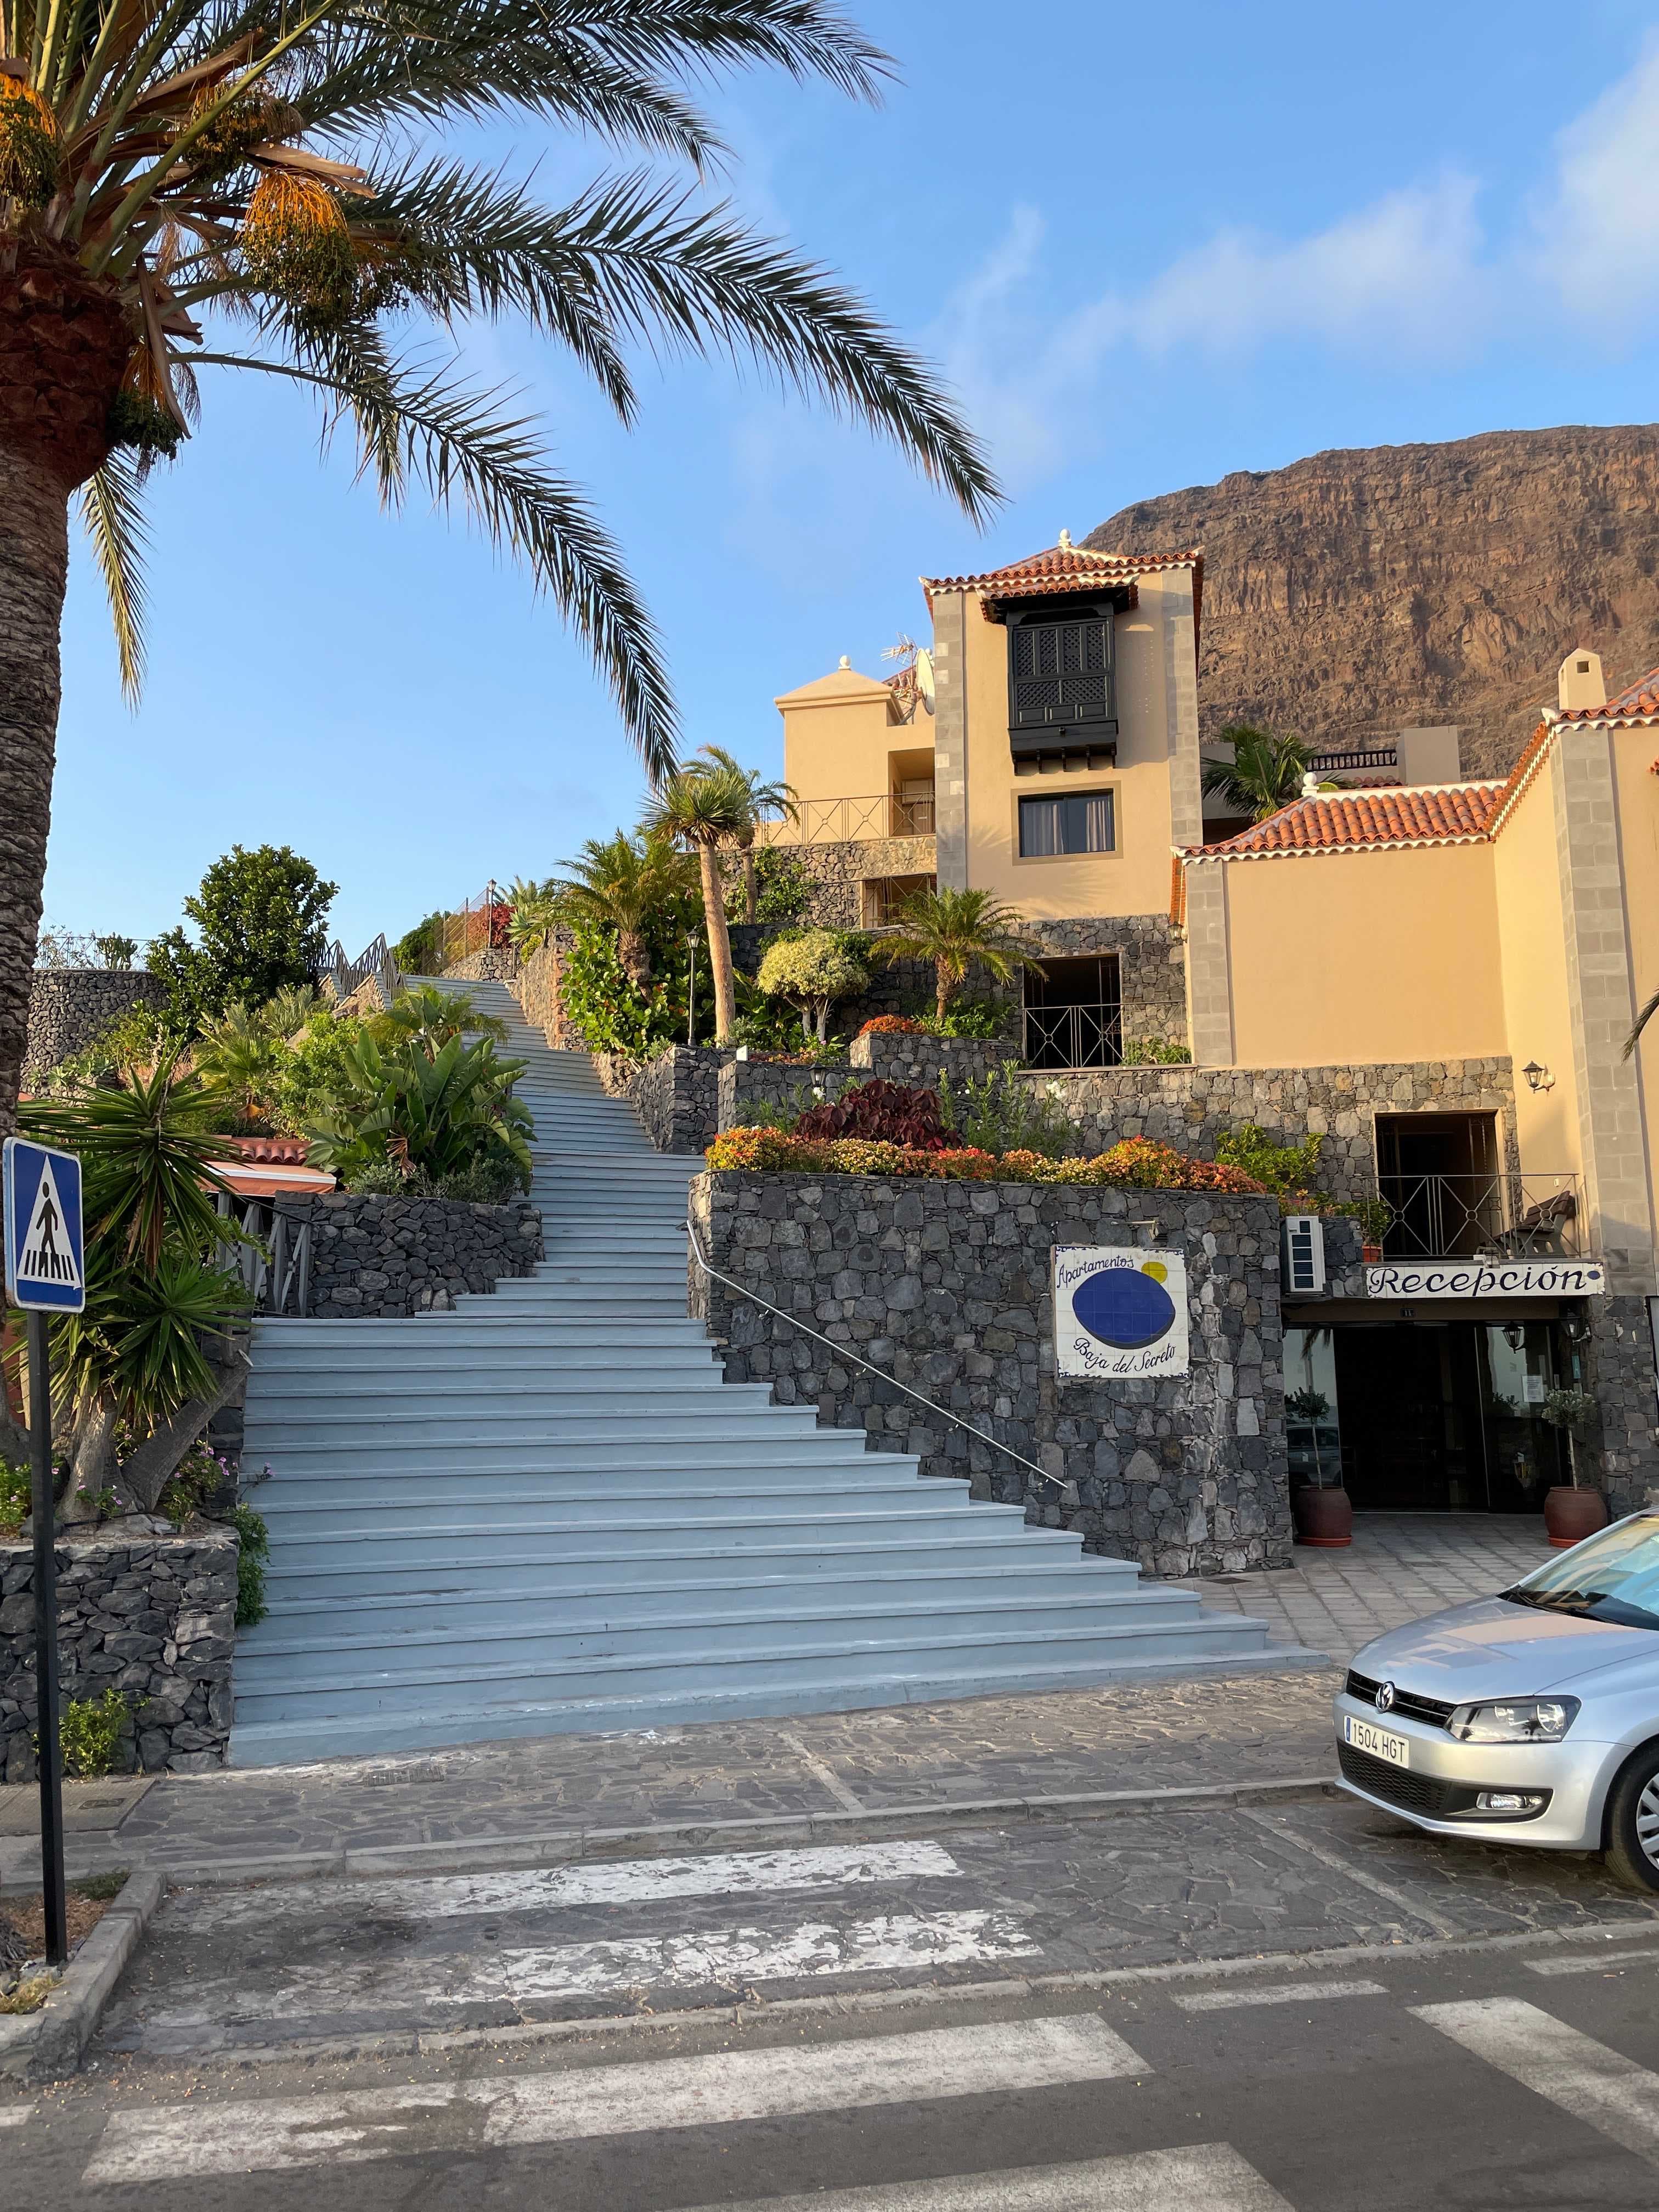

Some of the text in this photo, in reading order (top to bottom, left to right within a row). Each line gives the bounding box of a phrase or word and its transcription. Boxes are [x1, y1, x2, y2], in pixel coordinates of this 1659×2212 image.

[1057, 1255, 1134, 1288] Apartamentos
[1372, 1266, 1587, 1296] Recepción
[1074, 1338, 1176, 1373] Baja del Secreto
[1353, 1724, 1405, 1762] 1504 HGT
